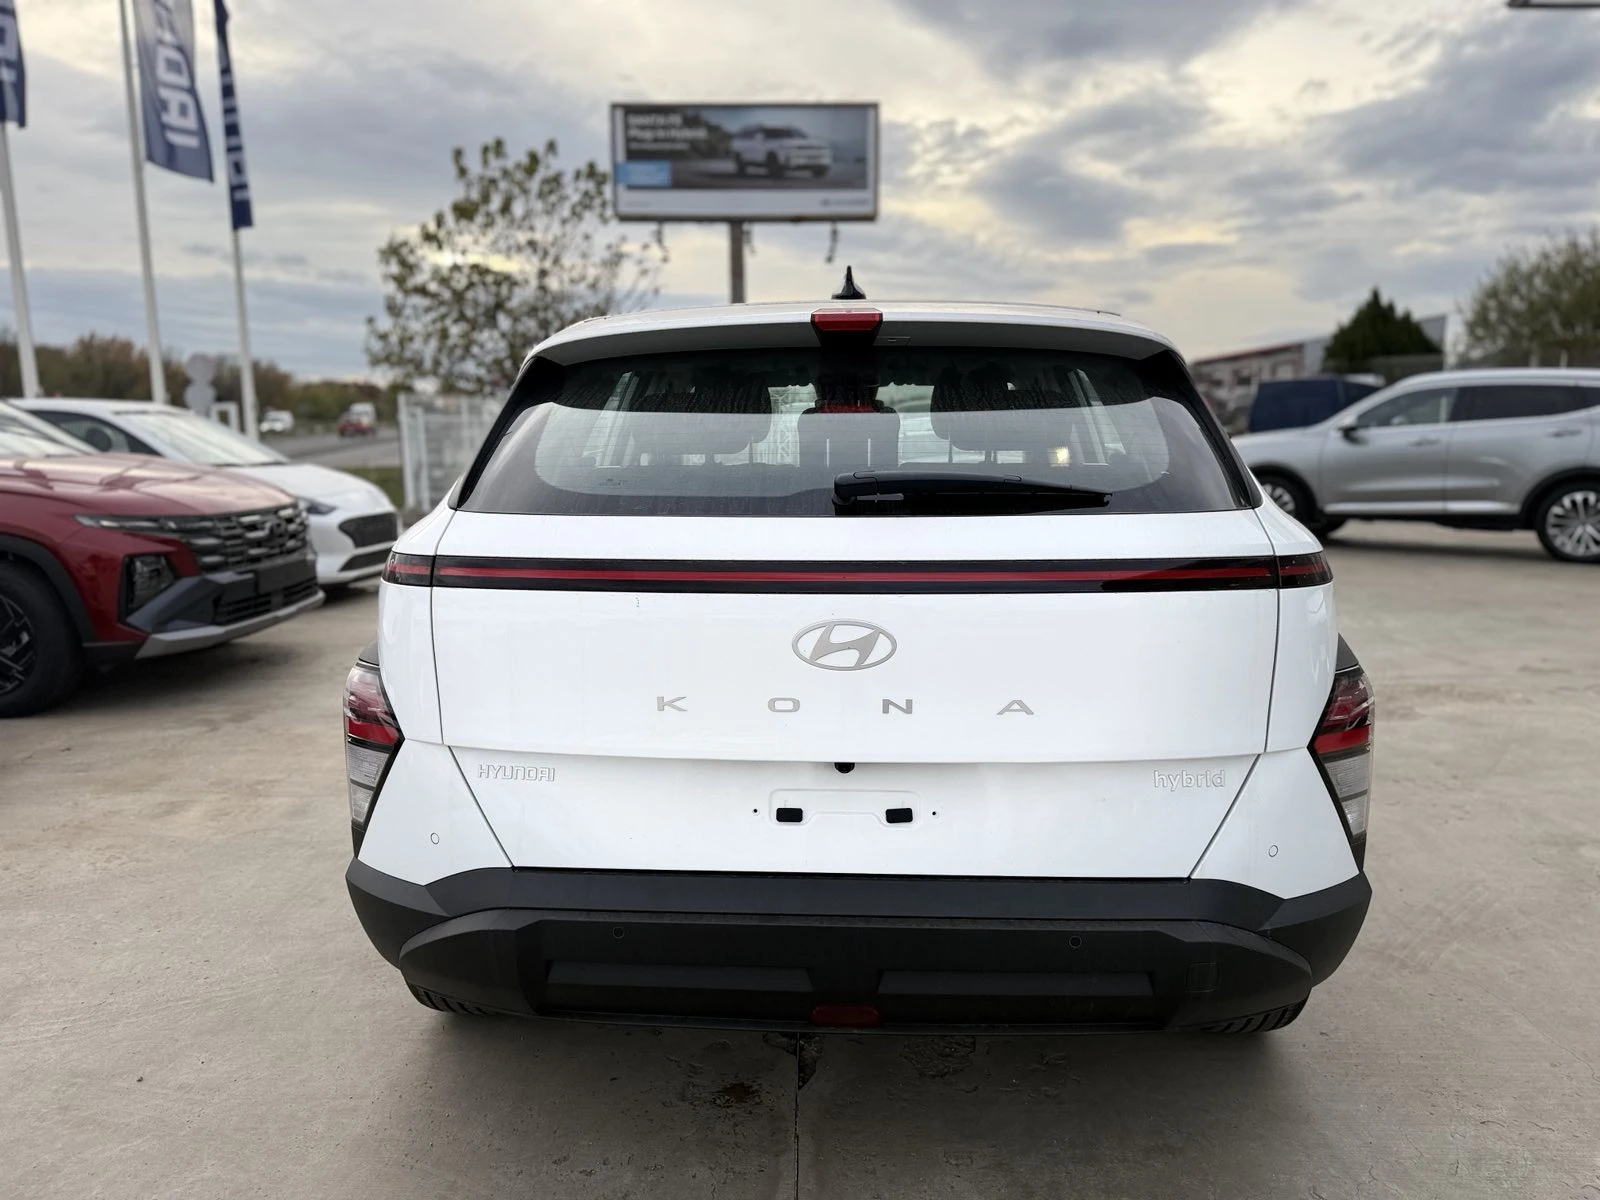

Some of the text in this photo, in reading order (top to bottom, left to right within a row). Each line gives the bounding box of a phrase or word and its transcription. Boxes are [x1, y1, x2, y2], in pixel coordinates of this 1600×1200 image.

[656, 695, 1035, 716] KONA
[478, 763, 556, 782] HYUNDAI
[1153, 769, 1226, 792] hybrid
